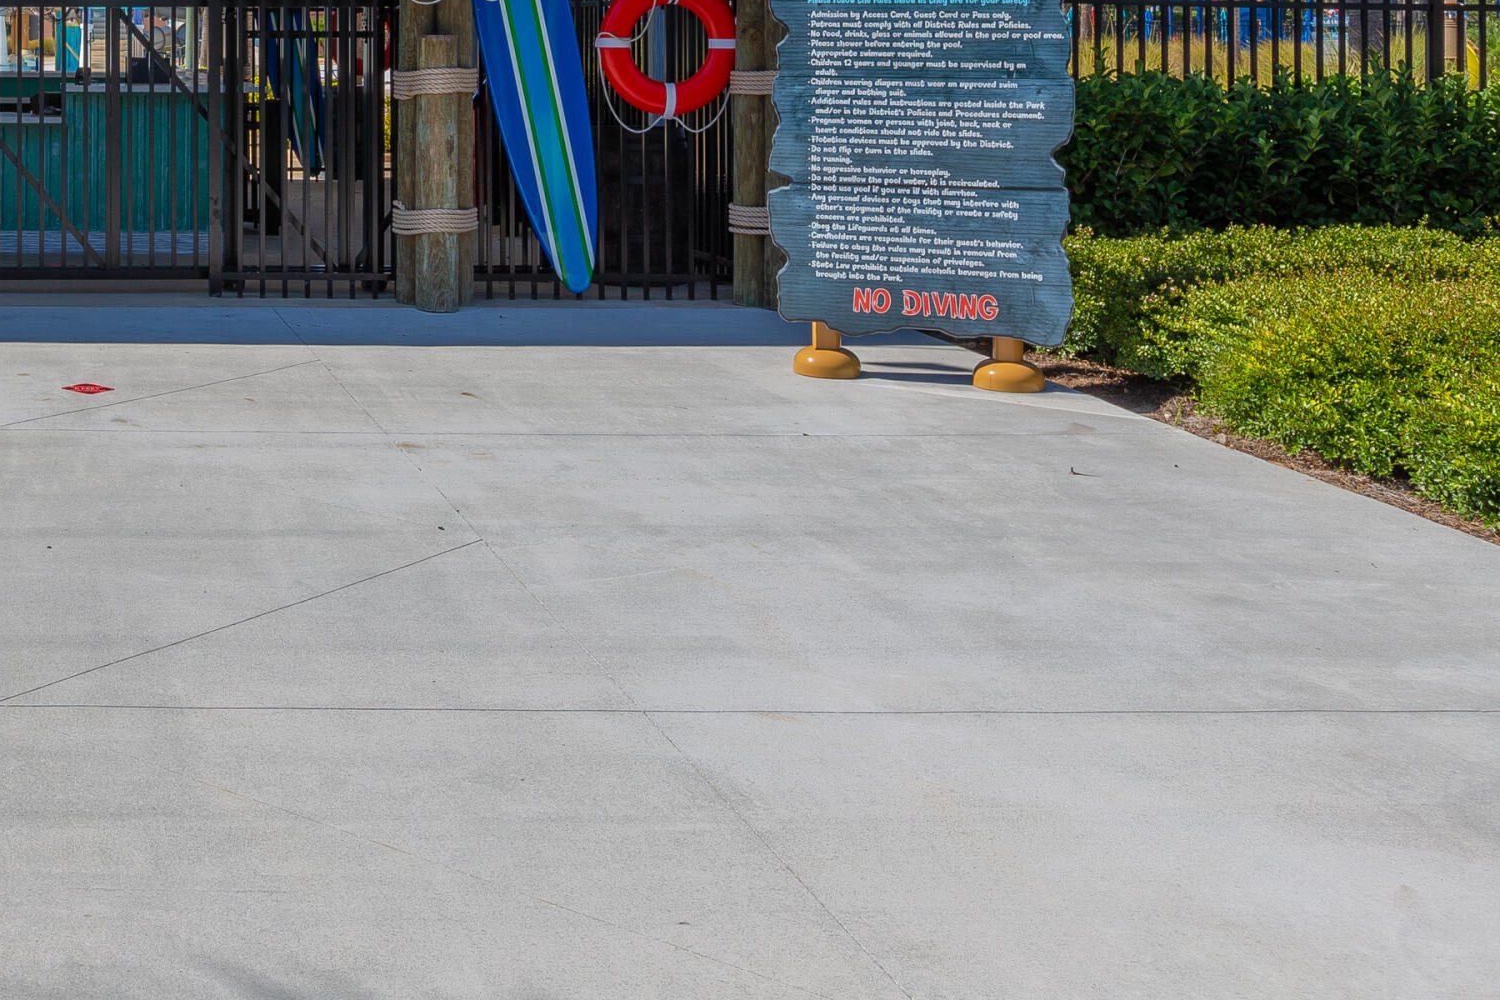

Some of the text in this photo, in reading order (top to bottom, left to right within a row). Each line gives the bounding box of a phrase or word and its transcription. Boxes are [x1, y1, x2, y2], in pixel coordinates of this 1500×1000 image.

[810, 10, 848, 18] Admission
[849, 10, 860, 20] by
[862, 10, 888, 18] Access
[913, 10, 936, 18] Guest
[938, 10, 958, 19] Card
[972, 10, 990, 19] Pass
[810, 19, 840, 28] Patrons
[842, 19, 862, 28] must
[863, 19, 891, 30] comply
[893, 19, 911, 28] with
[912, 20, 923, 28] all
[924, 20, 956, 28] District
[957, 20, 979, 28] Rules
[980, 20, 996, 29] and
[810, 29, 820, 38] No
[871, 29, 890, 40] glass
[903, 29, 932, 38] animals
[934, 29, 963, 38] allowed
[964, 30, 973, 38] in
[974, 30, 989, 38] the
[991, 30, 1010, 41] pool
[1022, 30, 1042, 41] pool
[810, 38, 834, 47] Please
[836, 38, 863, 48] shower
[864, 39, 890, 48] before
[892, 39, 924, 50] entering
[926, 39, 941, 48] the
[810, 48, 858, 59] Appropriate
[810, 58, 842, 67] Children
[843, 58, 852, 67] 12
[853, 60, 875, 69] years
[876, 58, 891, 67] and
[892, 60, 924, 70] younger
[925, 59, 946, 68] must
[947, 59, 958, 68] be
[959, 59, 1002, 70] supervised
[1003, 60, 1015, 70] by
[810, 77, 842, 86] Children
[843, 77, 873, 88] wearing
[874, 78, 903, 89] diapers
[904, 78, 925, 87] must
[958, 79, 997, 90] approved
[998, 79, 1018, 88] swim
[814, 86, 839, 98] diaper
[841, 87, 856, 96] and
[856, 87, 887, 98] bathing
[810, 96, 851, 105] Additional
[852, 97, 871, 106] rules
[873, 97, 887, 106] and
[889, 97, 936, 107] instructions
[953, 98, 982, 110] posted
[983, 99, 1007, 108] inside
[1008, 99, 1023, 108] the
[1025, 100, 1045, 109] Park
[843, 106, 851, 115] in
[852, 106, 866, 115] the
[906, 107, 936, 117] Policies
[938, 108, 953, 117] and
[954, 108, 1000, 118] Procedures
[848, 135, 877, 145] devices
[878, 136, 898, 145] must
[899, 136, 910, 146] be
[911, 137, 949, 148] approved
[949, 138, 961, 149] by
[962, 138, 977, 147] the
[810, 144, 821, 153] Do
[822, 144, 837, 153] not
[864, 145, 882, 155] turn
[883, 146, 892, 155] in
[893, 146, 907, 155] the
[810, 154, 821, 162] No
[810, 163, 821, 172] No
[862, 165, 897, 174] behavior
[810, 221, 830, 232] Obey
[831, 222, 845, 231] the
[889, 224, 899, 233] at
[900, 224, 911, 234] all
[810, 230, 857, 241] Cardholders
[873, 233, 917, 246] responsible
[918, 235, 932, 244] for
[933, 236, 954, 245] their
[815, 269, 847, 281] brought
[848, 270, 865, 280] into
[866, 272, 880, 281] the
[853, 287, 999, 321] NO DIVING
